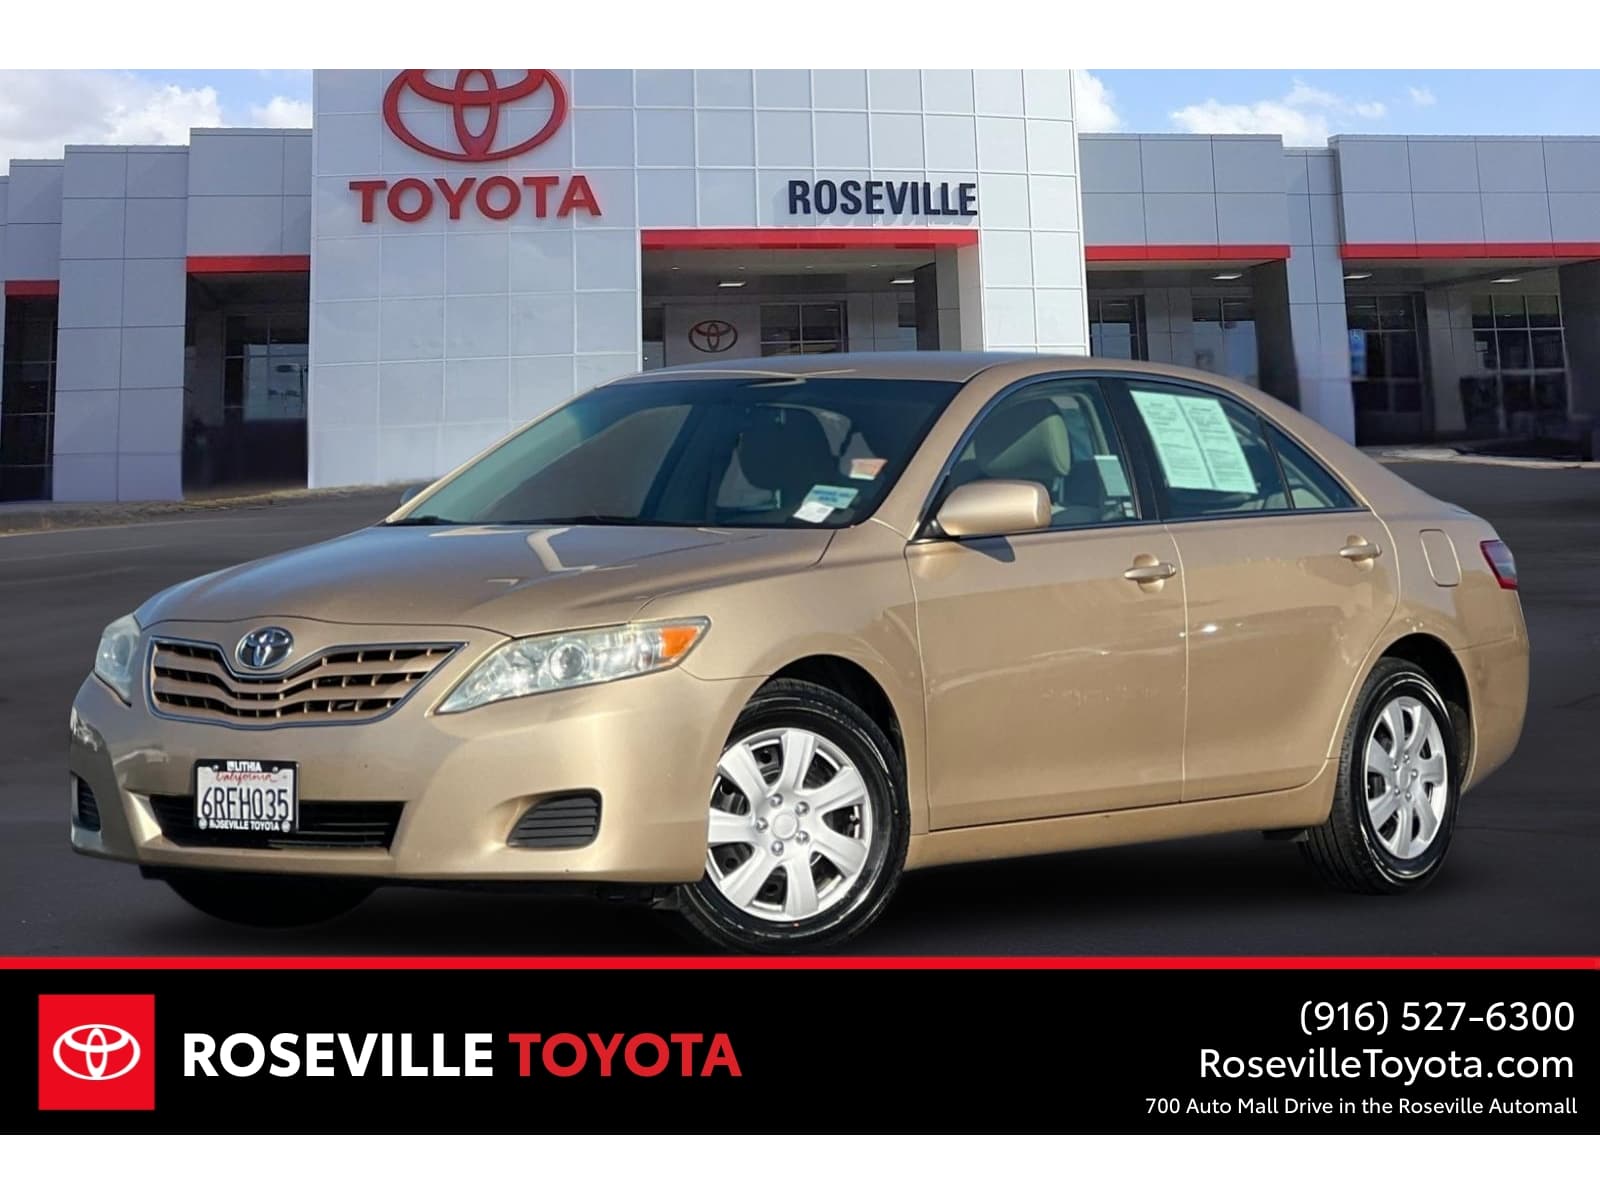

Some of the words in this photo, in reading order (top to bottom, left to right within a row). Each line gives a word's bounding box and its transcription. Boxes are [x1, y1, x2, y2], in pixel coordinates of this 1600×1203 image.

[349, 175, 602, 223] TOYOTA
[788, 179, 979, 217] ROSEVILLE
[201, 787, 289, 820] 6RFH035
[208, 819, 249, 830] ROSEVILLE
[250, 820, 280, 831] TOYOTA
